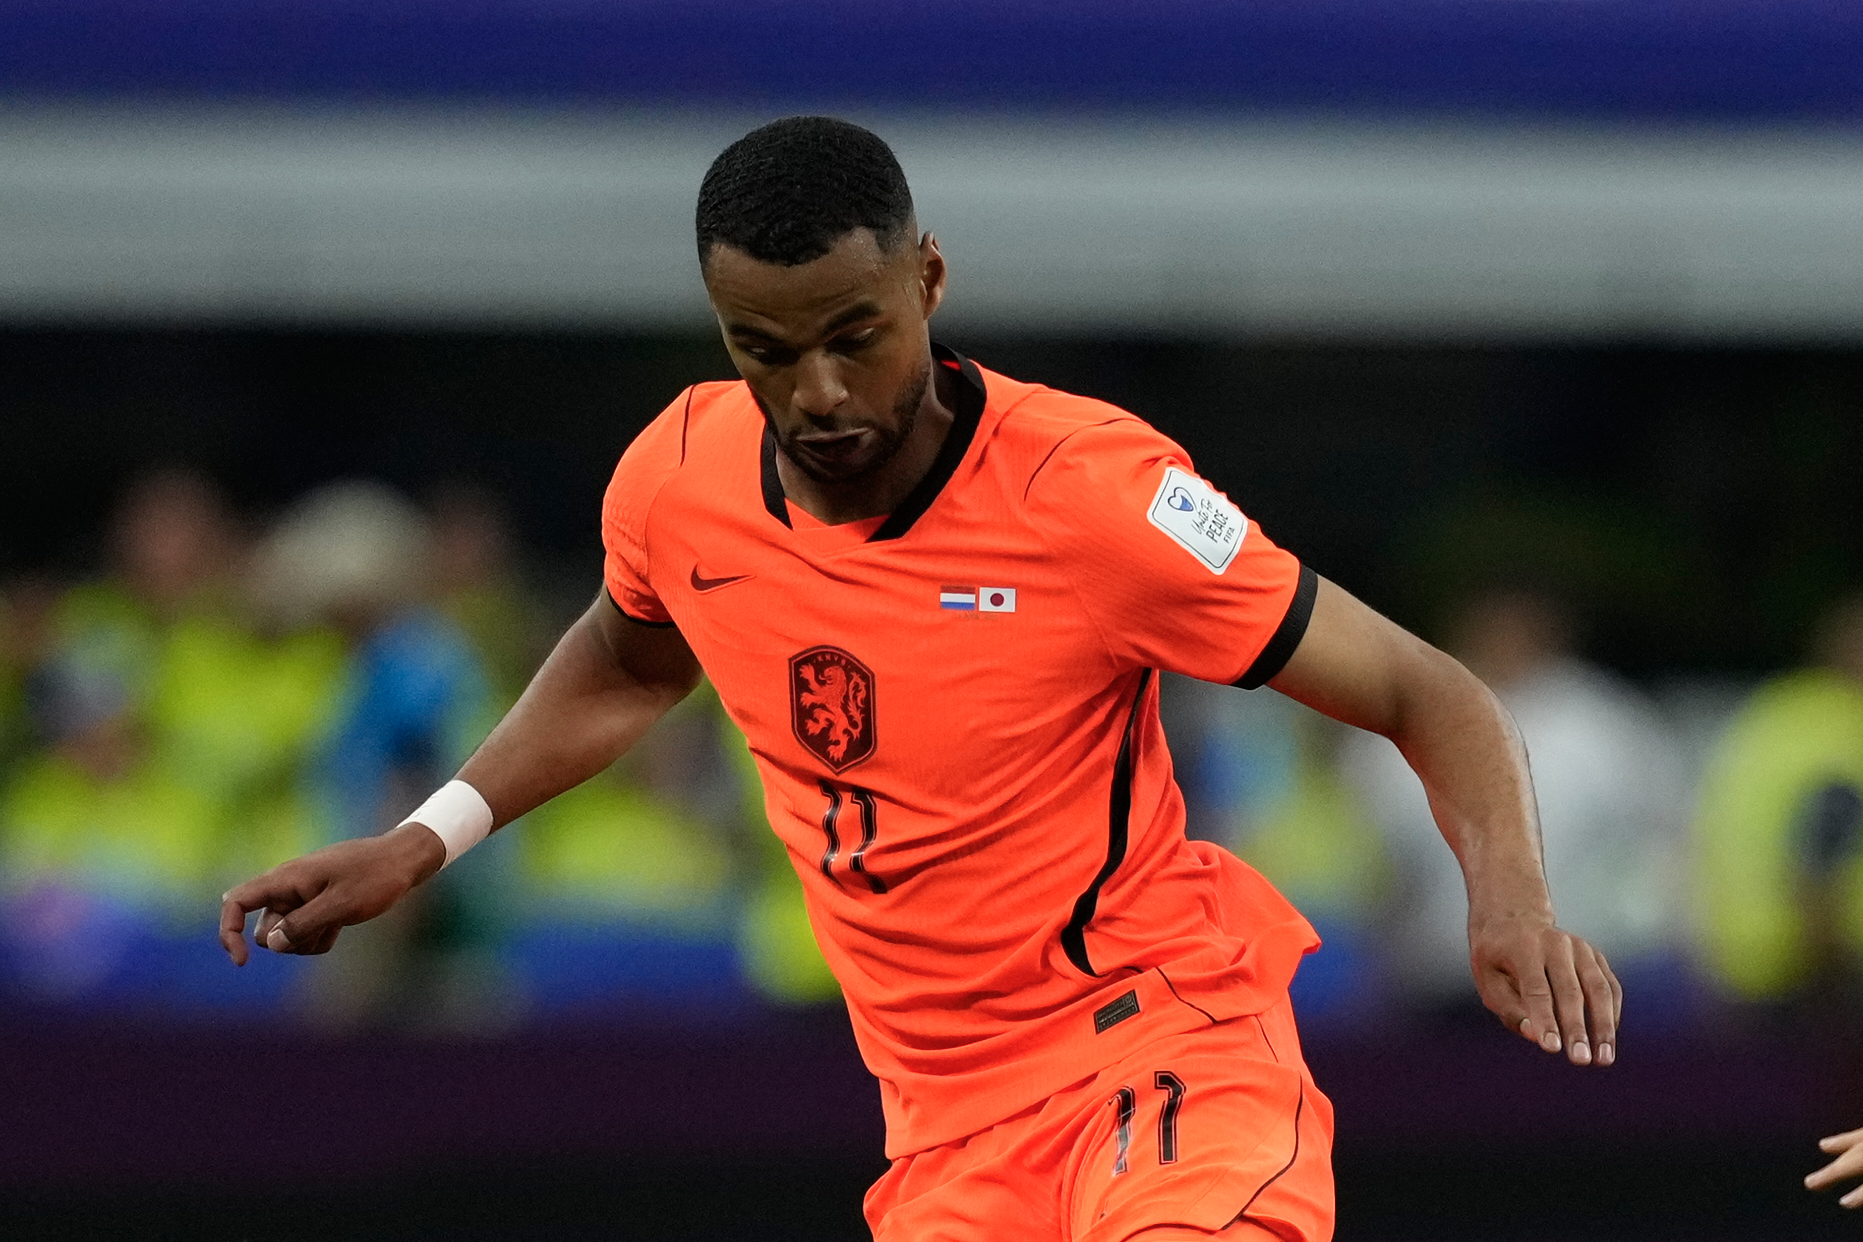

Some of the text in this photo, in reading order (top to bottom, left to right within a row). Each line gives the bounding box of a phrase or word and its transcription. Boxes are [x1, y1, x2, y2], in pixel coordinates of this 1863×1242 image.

[1206, 509, 1229, 543] PEACE
[1223, 527, 1235, 544] FIFA
[1107, 1070, 1187, 1177] 11
